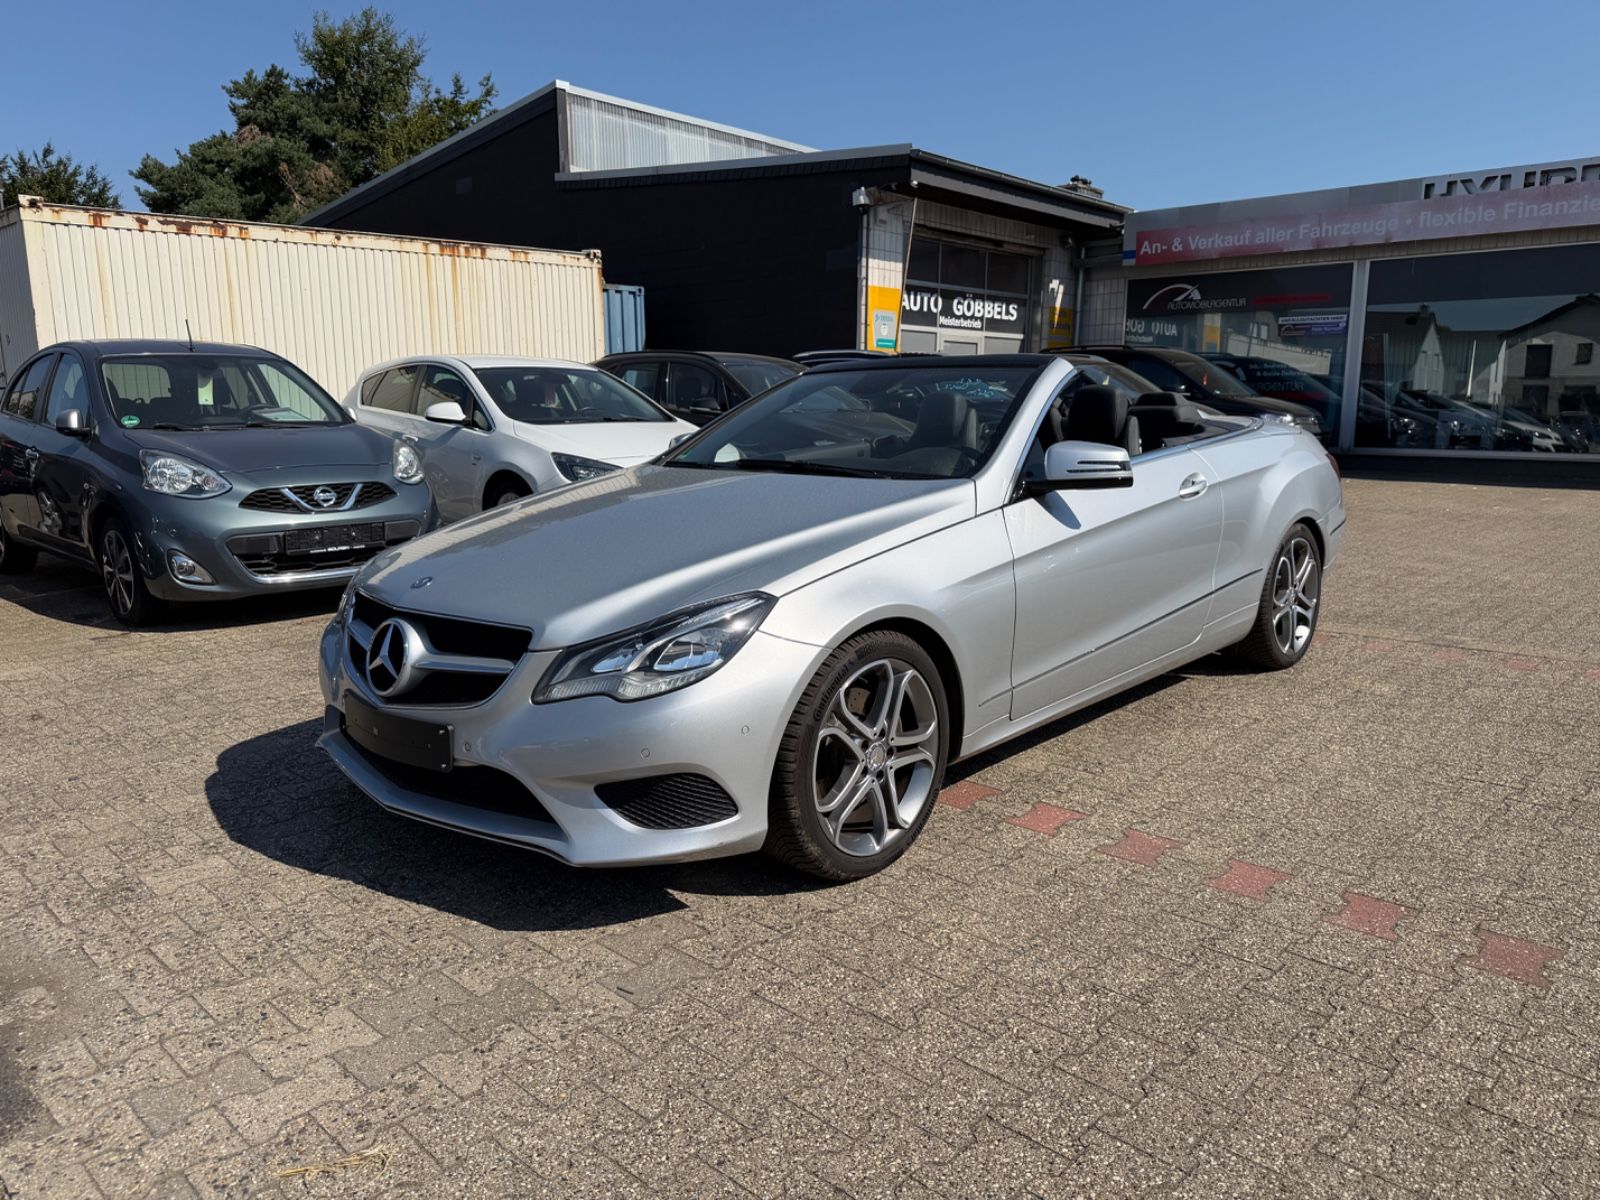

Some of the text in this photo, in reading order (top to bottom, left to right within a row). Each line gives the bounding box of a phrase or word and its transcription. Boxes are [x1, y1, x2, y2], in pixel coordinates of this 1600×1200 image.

[1139, 194, 1600, 255] An- & Verkauf aller Fahrzeuge flexible Finanzie
[901, 290, 1019, 321] AUTO GÖBBELS
[1167, 297, 1247, 311] AUTOMOBILAGENTUR
[939, 315, 982, 329] Meisterbetrieb
[813, 664, 850, 721] Continental
